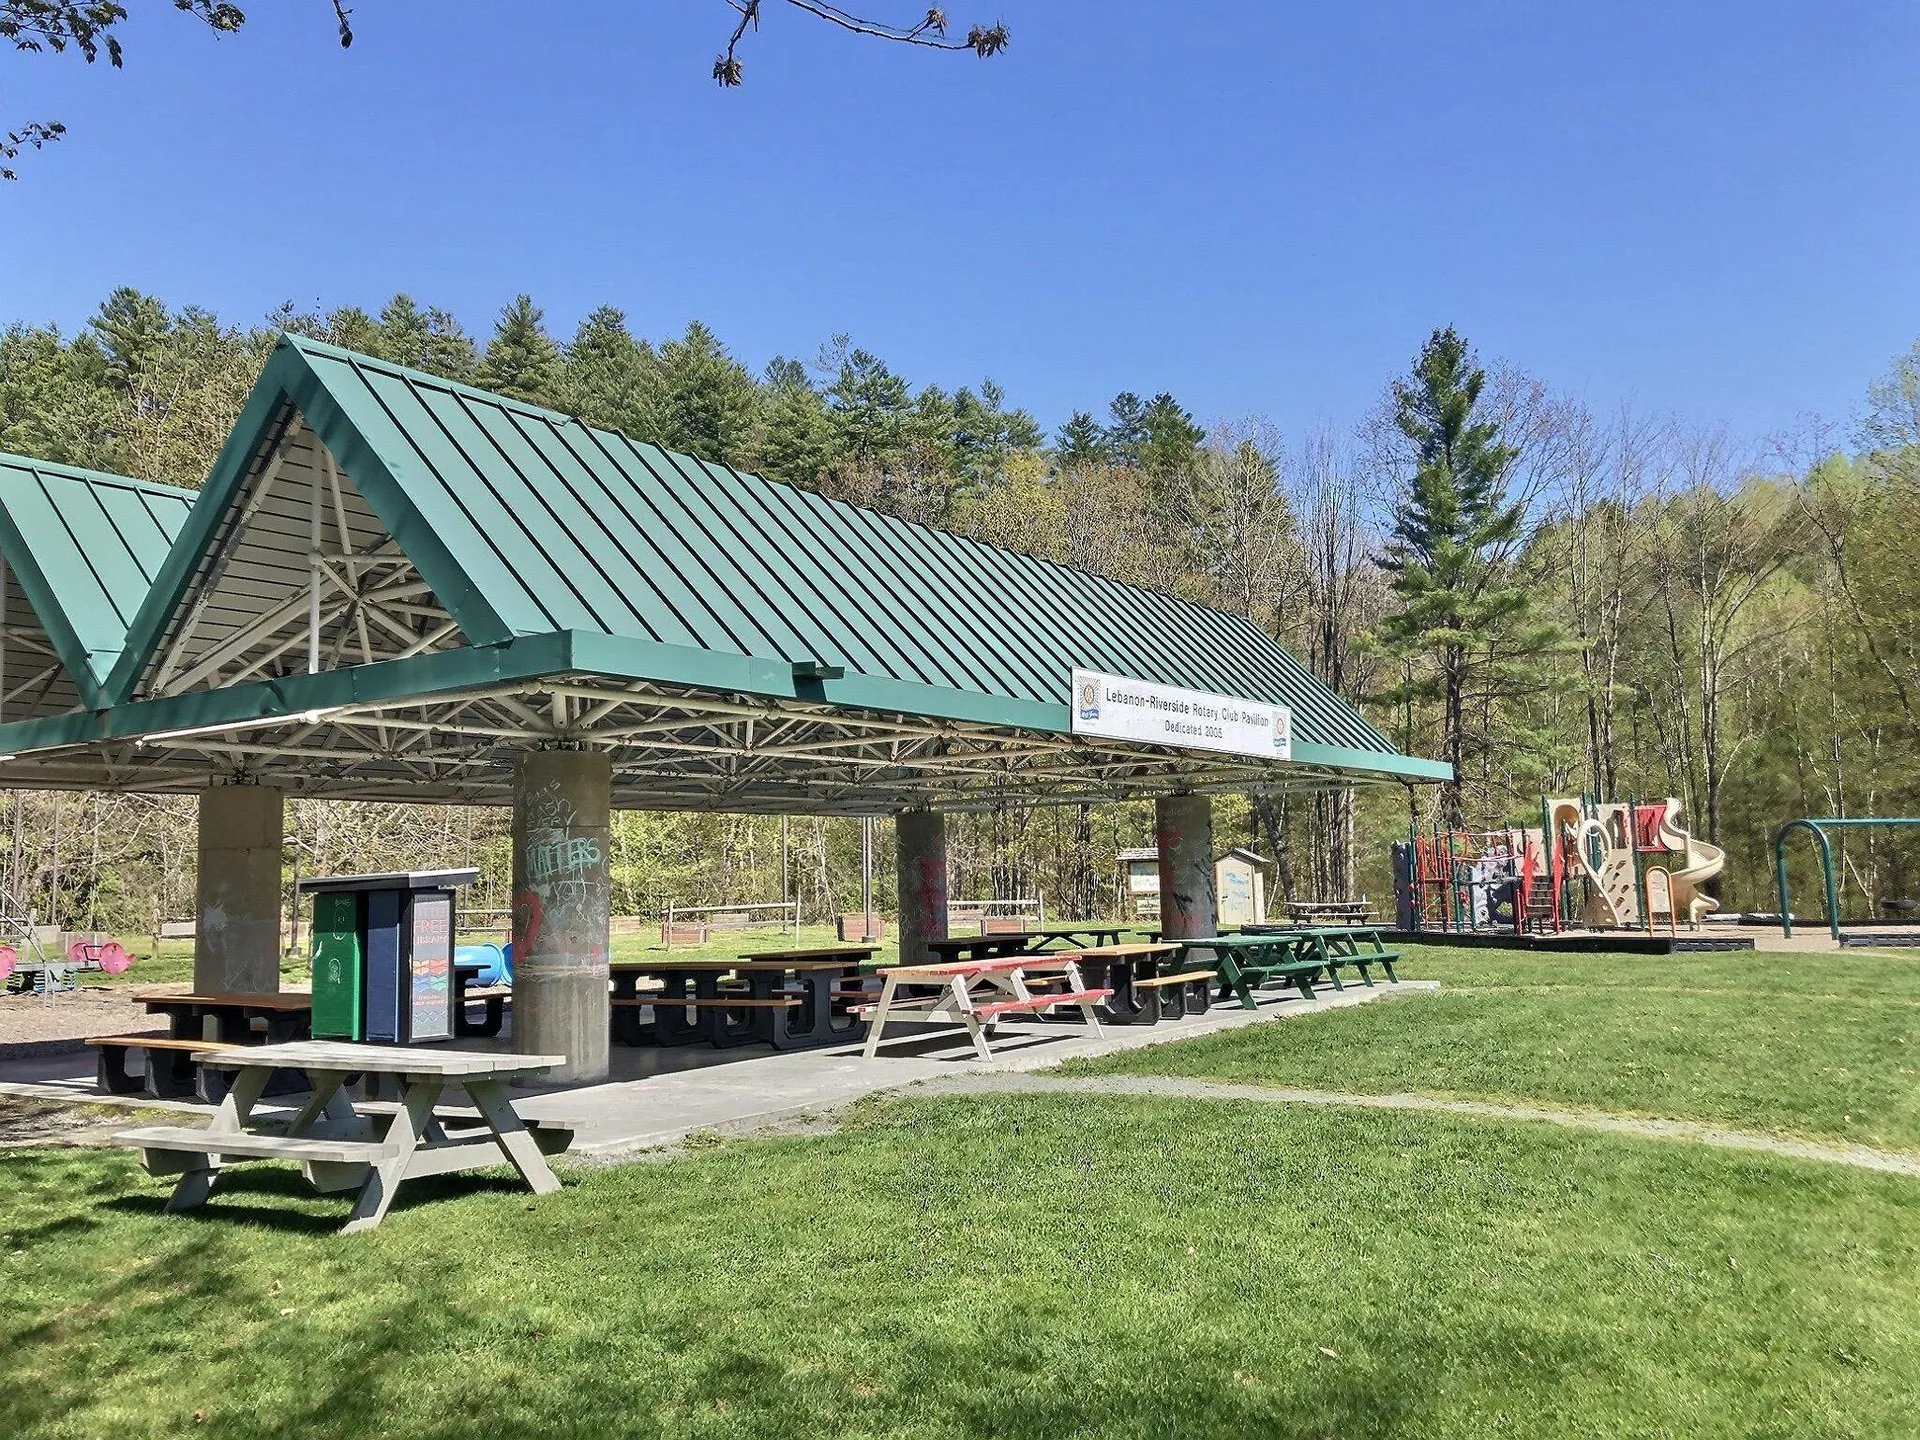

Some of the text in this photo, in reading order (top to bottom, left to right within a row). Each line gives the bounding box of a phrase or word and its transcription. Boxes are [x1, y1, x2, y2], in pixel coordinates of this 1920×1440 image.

[1106, 688, 1189, 714] Lebanon-Riverside
[1192, 703, 1219, 721] Rotary
[1222, 708, 1239, 722] Club
[1242, 711, 1269, 727] Pavilion
[1165, 720, 1202, 736] Dedicated
